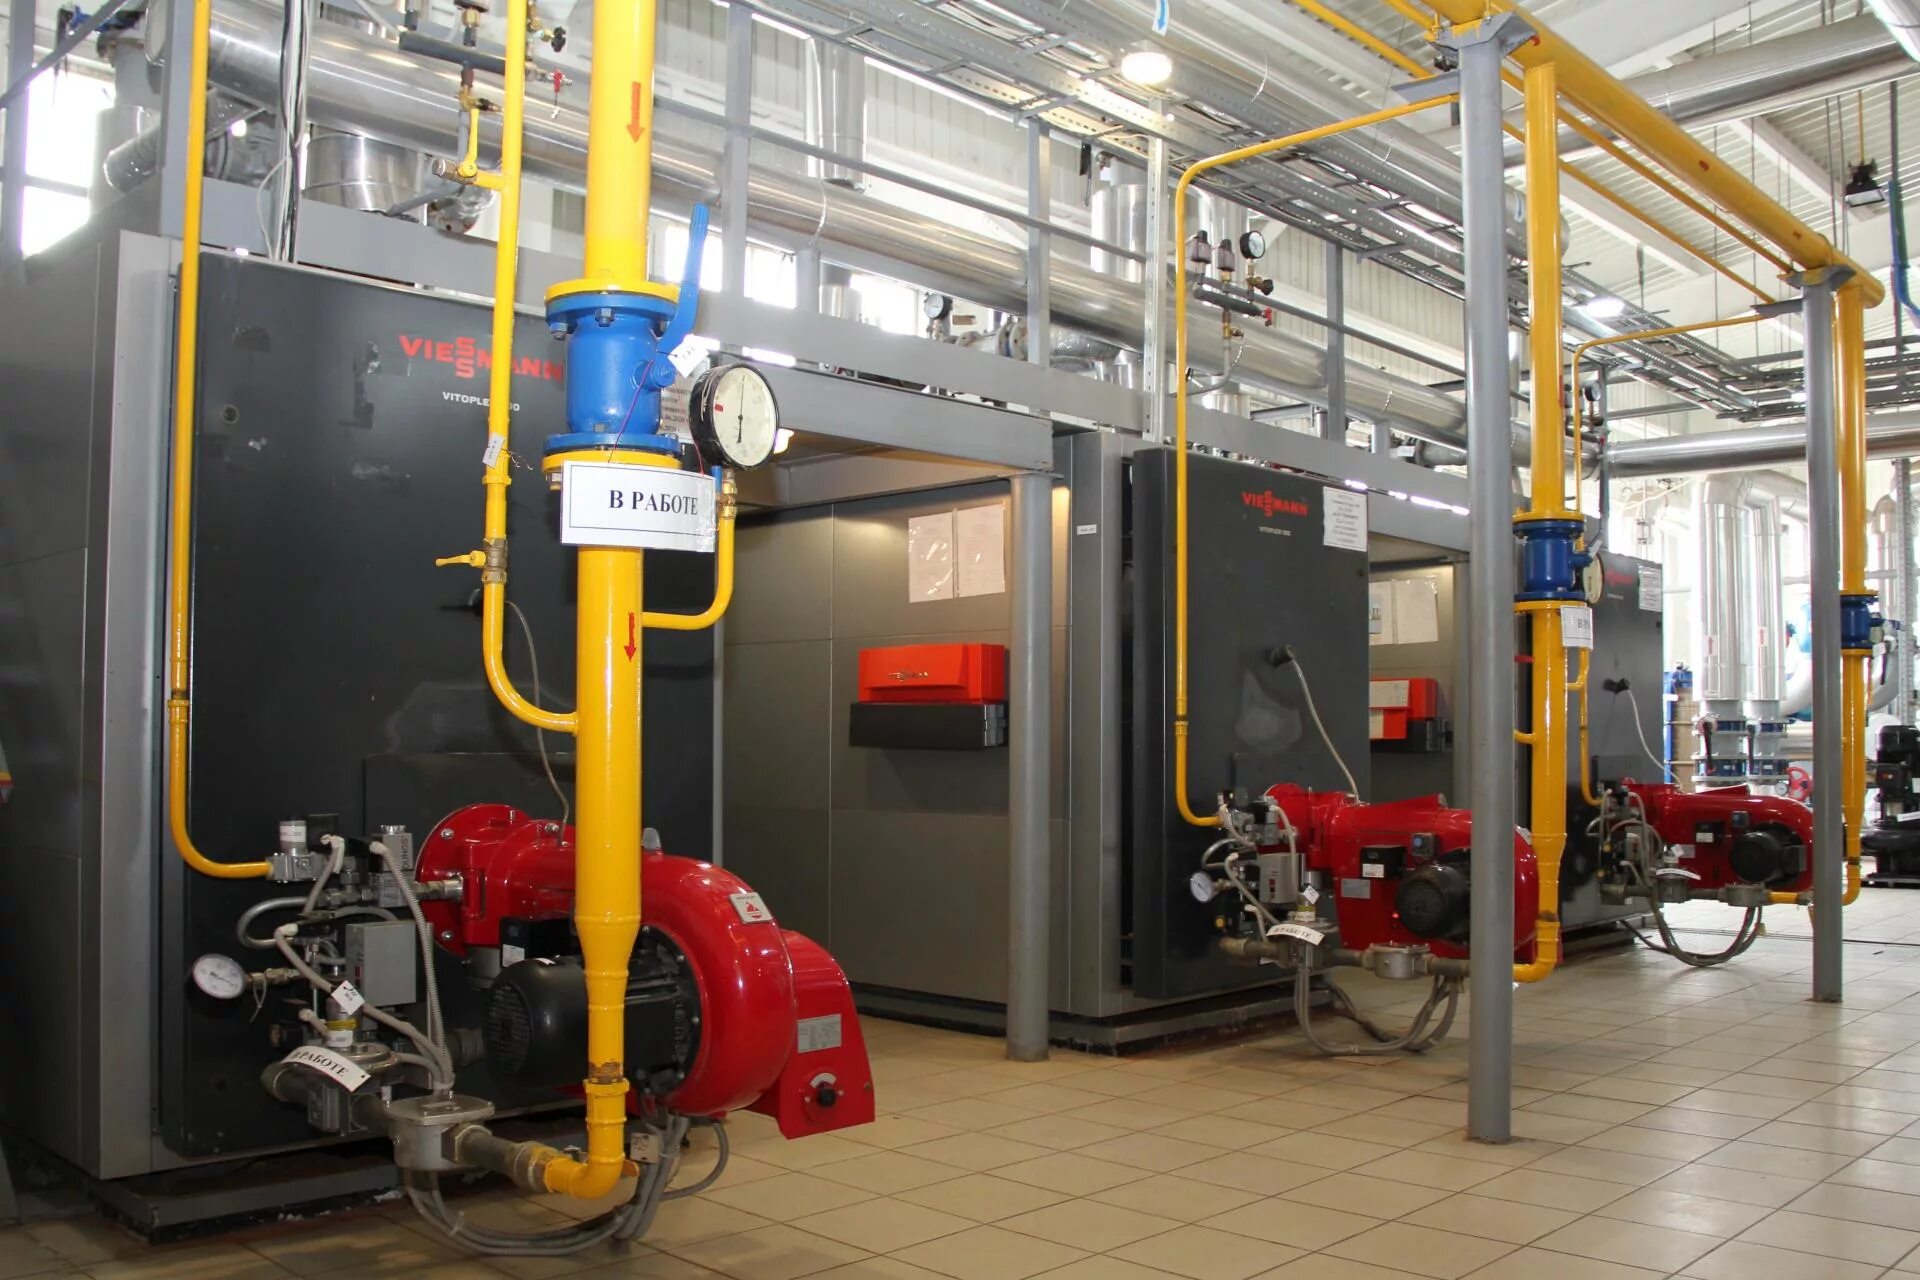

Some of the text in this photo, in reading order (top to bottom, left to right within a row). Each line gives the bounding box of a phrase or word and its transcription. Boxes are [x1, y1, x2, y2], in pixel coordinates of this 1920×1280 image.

[442, 391, 491, 407] VITOPLE
[608, 490, 698, 515] В РАБОТЕ
[1242, 490, 1308, 518] VIESSMANN
[299, 1051, 349, 1077] РАБОТЕ
